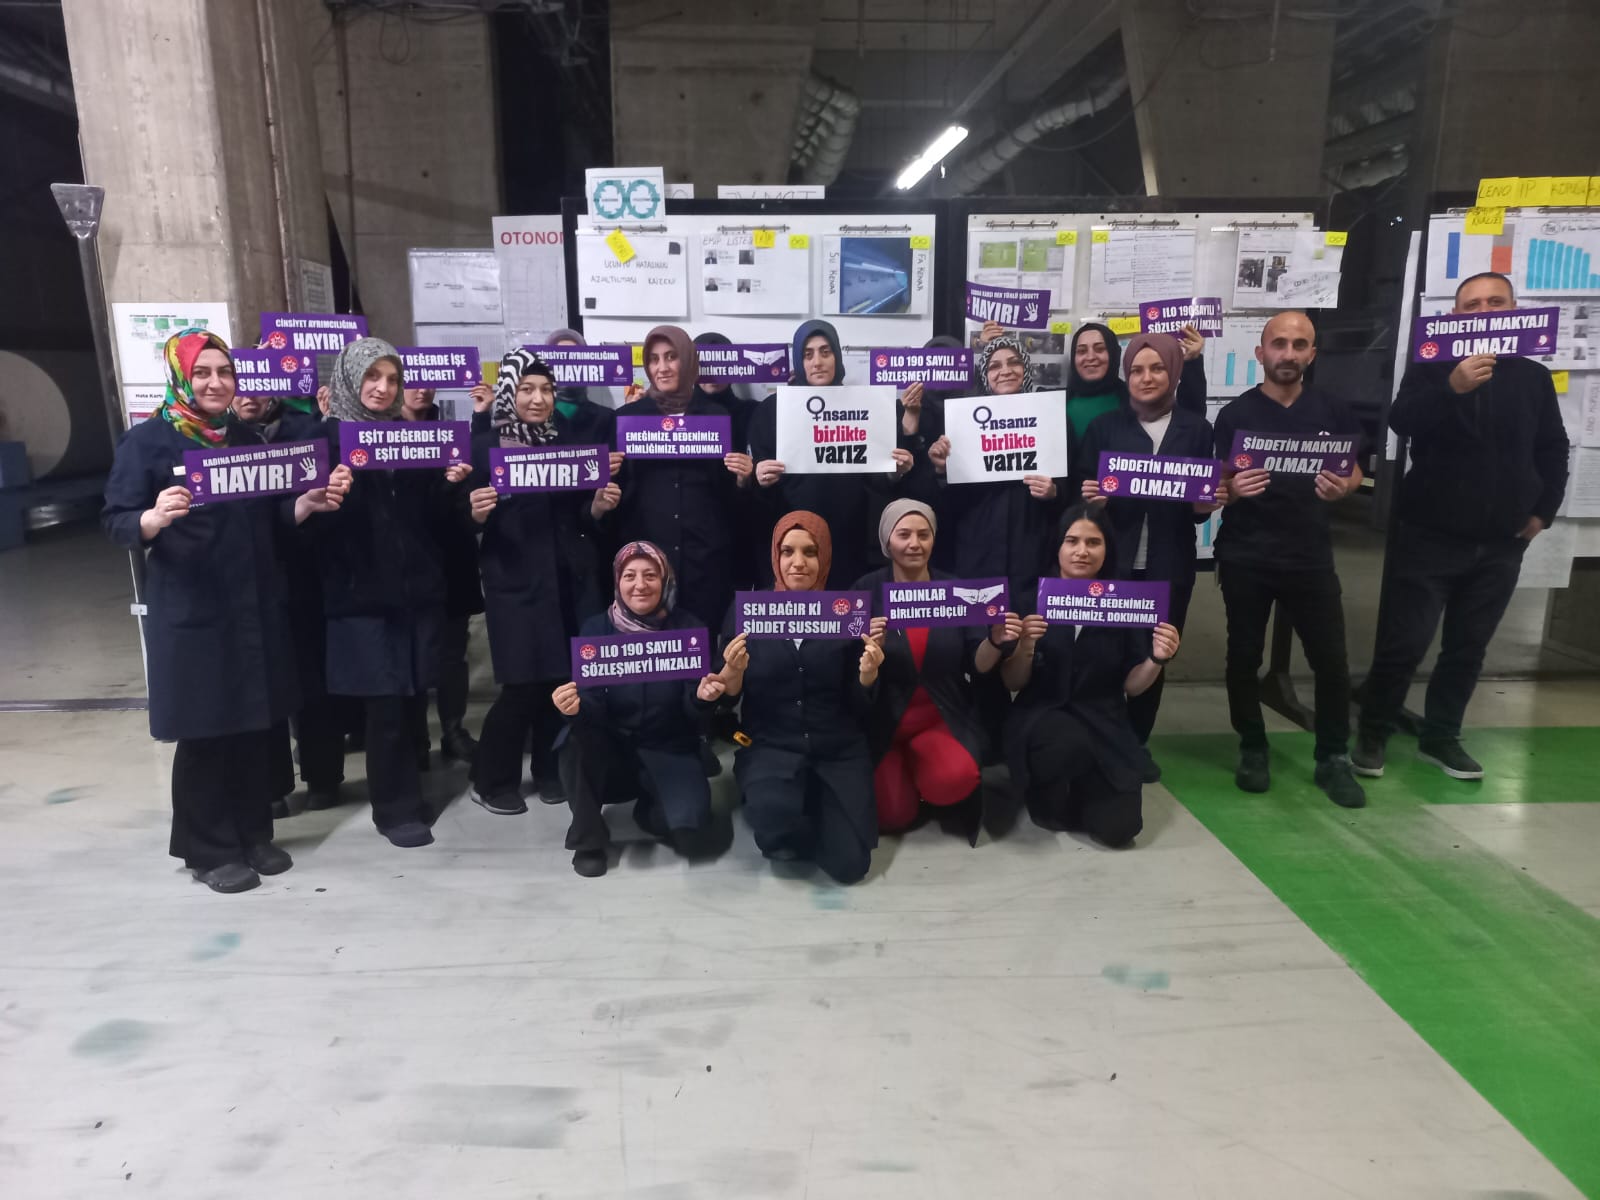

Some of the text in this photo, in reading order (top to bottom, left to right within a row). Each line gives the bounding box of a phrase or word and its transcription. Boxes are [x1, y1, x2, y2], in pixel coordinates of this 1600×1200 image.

[972, 296, 1020, 325] HAYIR!
[1162, 306, 1177, 319] ILO
[1194, 305, 1215, 317] SAYILI
[275, 318, 358, 330] CİNSİYET AYRIMCILIĞINA
[1426, 314, 1548, 338] ŞİDDETİN MAKYAJI
[293, 332, 345, 351] HAYIR!
[1452, 336, 1518, 357] OLMAZ!
[406, 353, 450, 366] DEĞERDE
[450, 353, 467, 368] İŞE
[568, 351, 619, 361] AYRIMCILIĞINA
[697, 351, 738, 362] ADINLAR
[890, 355, 954, 367] ILO 190 SAYILI
[257, 358, 270, 374] Kİ
[553, 364, 604, 382] HAYIR!
[698, 365, 756, 377] İRLİKTE GÜÇLÜ!
[403, 369, 456, 383] ŞİT ÜCRET!
[876, 369, 969, 384] SÖZLEŞMEYİ İMZALA!
[238, 378, 292, 392] SUSSUN!
[358, 428, 454, 446] EŞİT DEĞERDE İŞE
[626, 430, 720, 443] EMEĞİMİZE, BEDENİMİZE
[813, 425, 867, 443] birlikte
[626, 443, 723, 455] KİMLİĞİMİZE, DOKUNMA!
[980, 434, 1036, 453] birlikte
[1243, 436, 1352, 454] ŞİDDETİN MAKYAJI
[203, 444, 314, 468] KADINA KARŞI HER TÜRLÜ ŞİDDETE
[375, 446, 440, 462] EŞİT ÜCRET!
[504, 454, 527, 463] KADINA
[527, 452, 545, 462] KARŞI
[545, 451, 557, 460] HER
[557, 449, 575, 459] TÜRLÜ
[815, 444, 867, 465] varız
[983, 451, 1038, 472] varız
[1108, 457, 1213, 477] ŞİDDETİN MAKYAJI
[1263, 457, 1324, 475] OLMAZ!
[210, 463, 292, 495] HAYIR!
[509, 463, 579, 487] HAYIR!
[1130, 478, 1186, 498] OLMAZ!
[889, 588, 946, 603] KADINLAR
[1047, 595, 1155, 610] EMEĞİMİZE, BEDENİMİZE
[743, 601, 821, 616] SEN BAĞIR Kİ
[890, 605, 967, 620] BİRLİKTE GÜÇLÜ!
[1046, 608, 1158, 624] KİMLİĞİMİZE, DOKUNMA!
[788, 620, 841, 634] SUSSUN!
[600, 640, 682, 659] ILO 190 SAYILI
[581, 656, 702, 678] SÖZLEŞMEYİ İMZALA!
